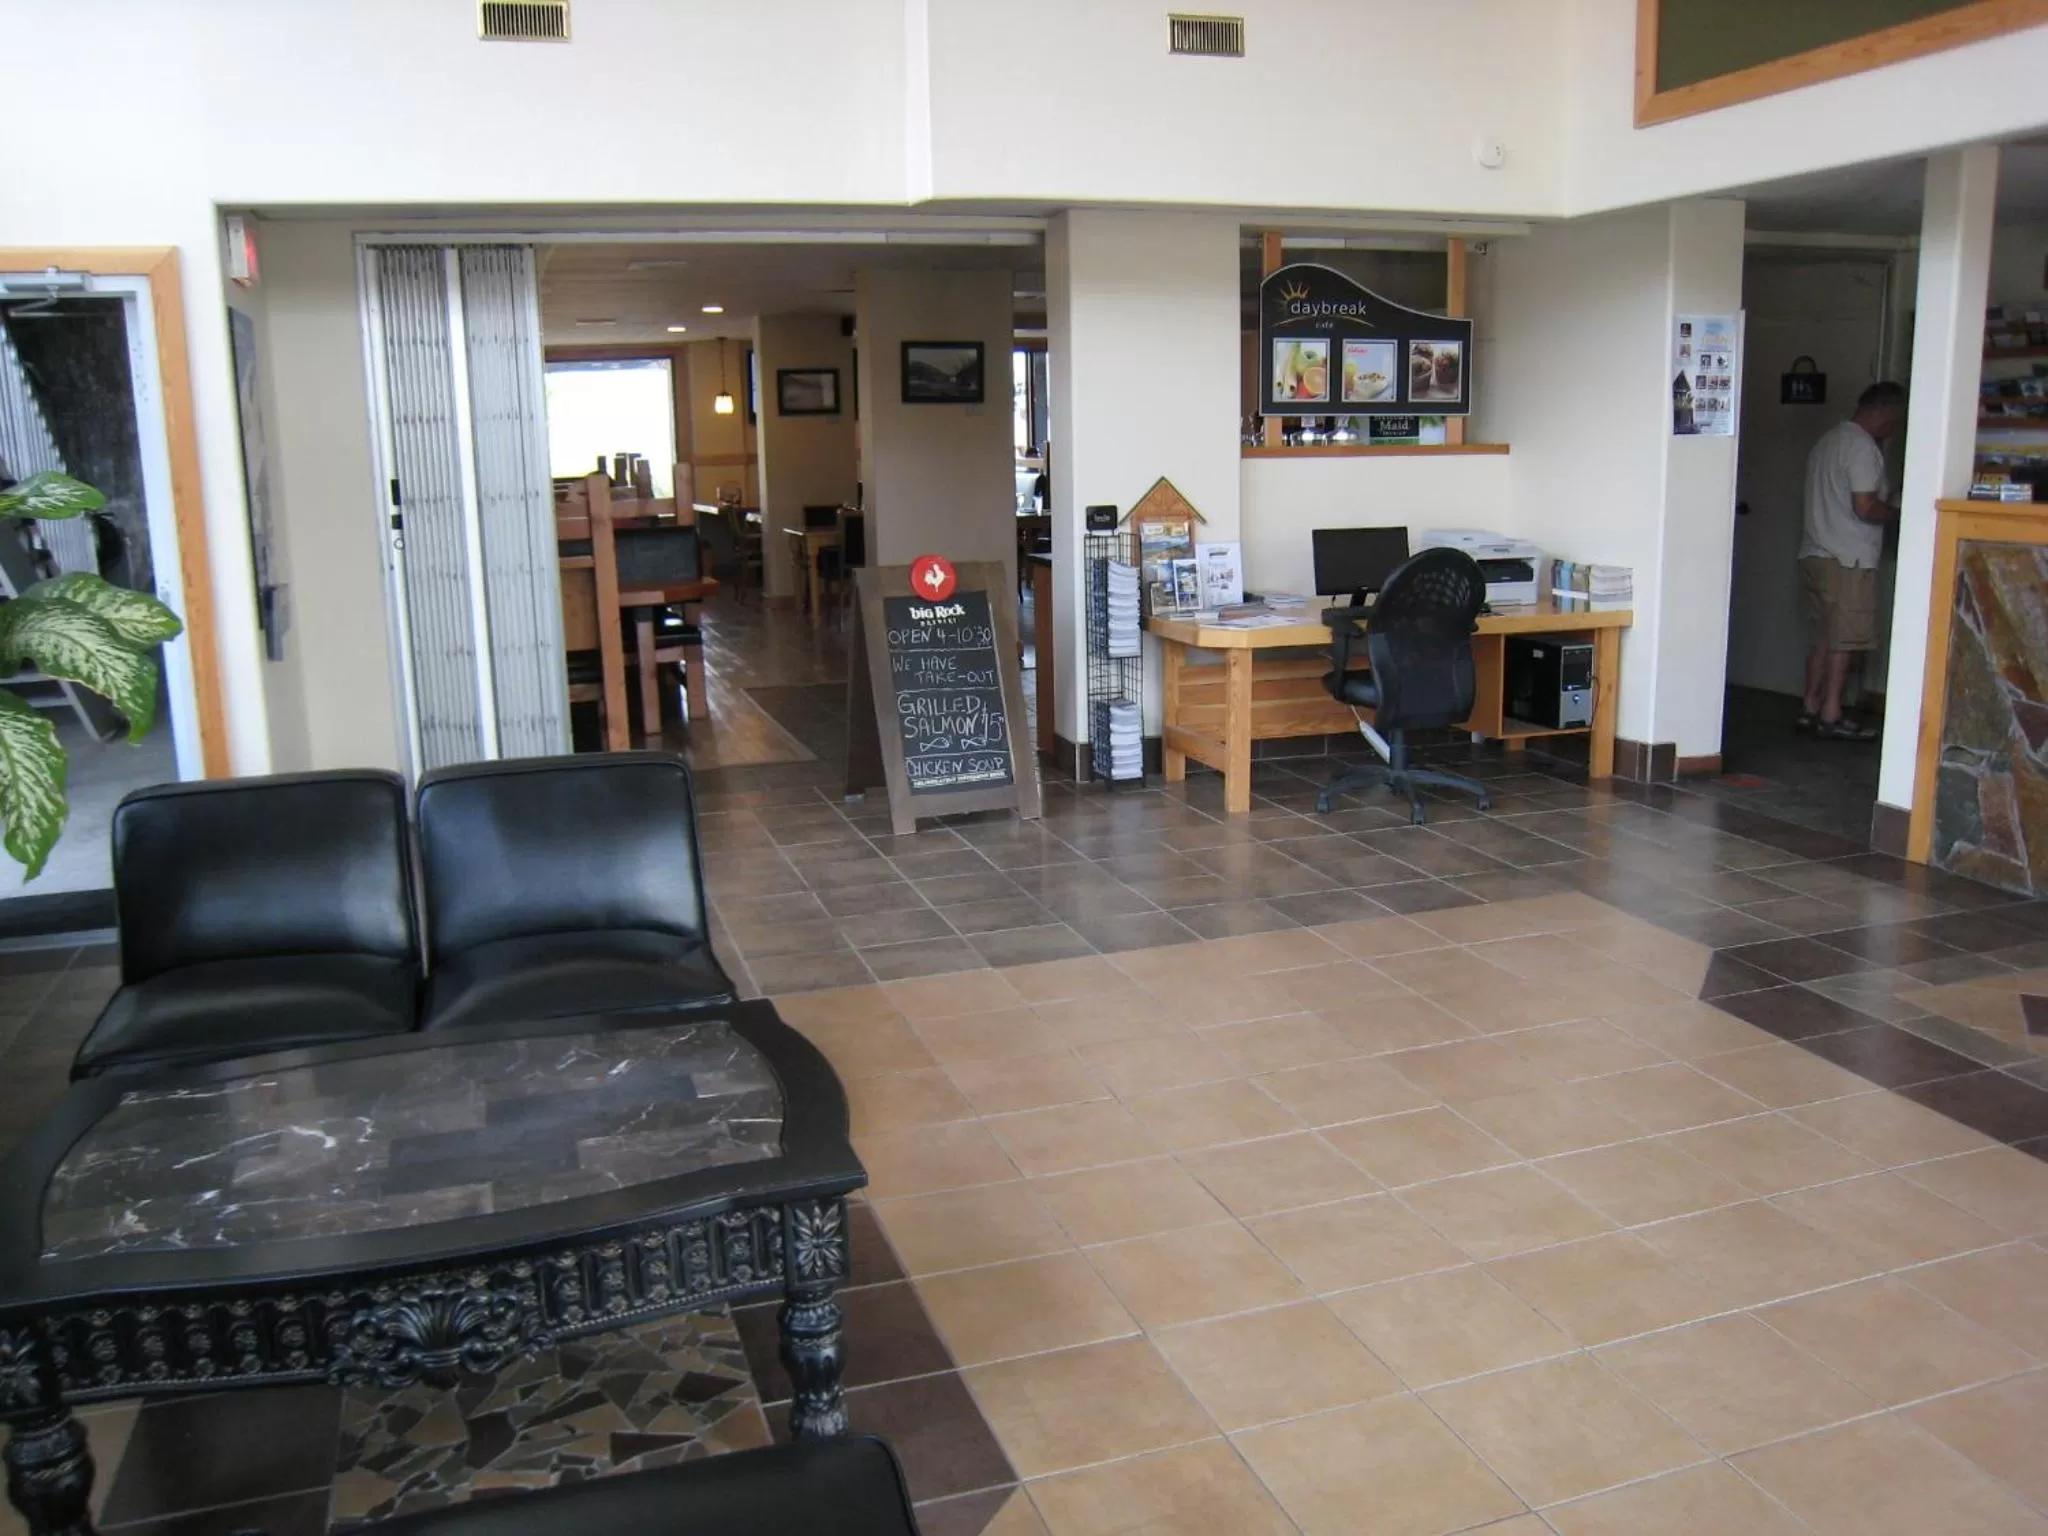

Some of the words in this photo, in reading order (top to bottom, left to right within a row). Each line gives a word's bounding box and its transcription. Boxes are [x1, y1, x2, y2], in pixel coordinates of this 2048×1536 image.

[1291, 300, 1367, 317] daybreak
[934, 604, 966, 618] Rock
[888, 627, 932, 645] OPEN
[893, 655, 912, 673] WE
[921, 655, 957, 671] HAVE
[897, 694, 981, 717] GRILLED
[904, 712, 980, 738] SALMON
[906, 758, 964, 777] CHICKEN
[968, 757, 1004, 773] SOUP
